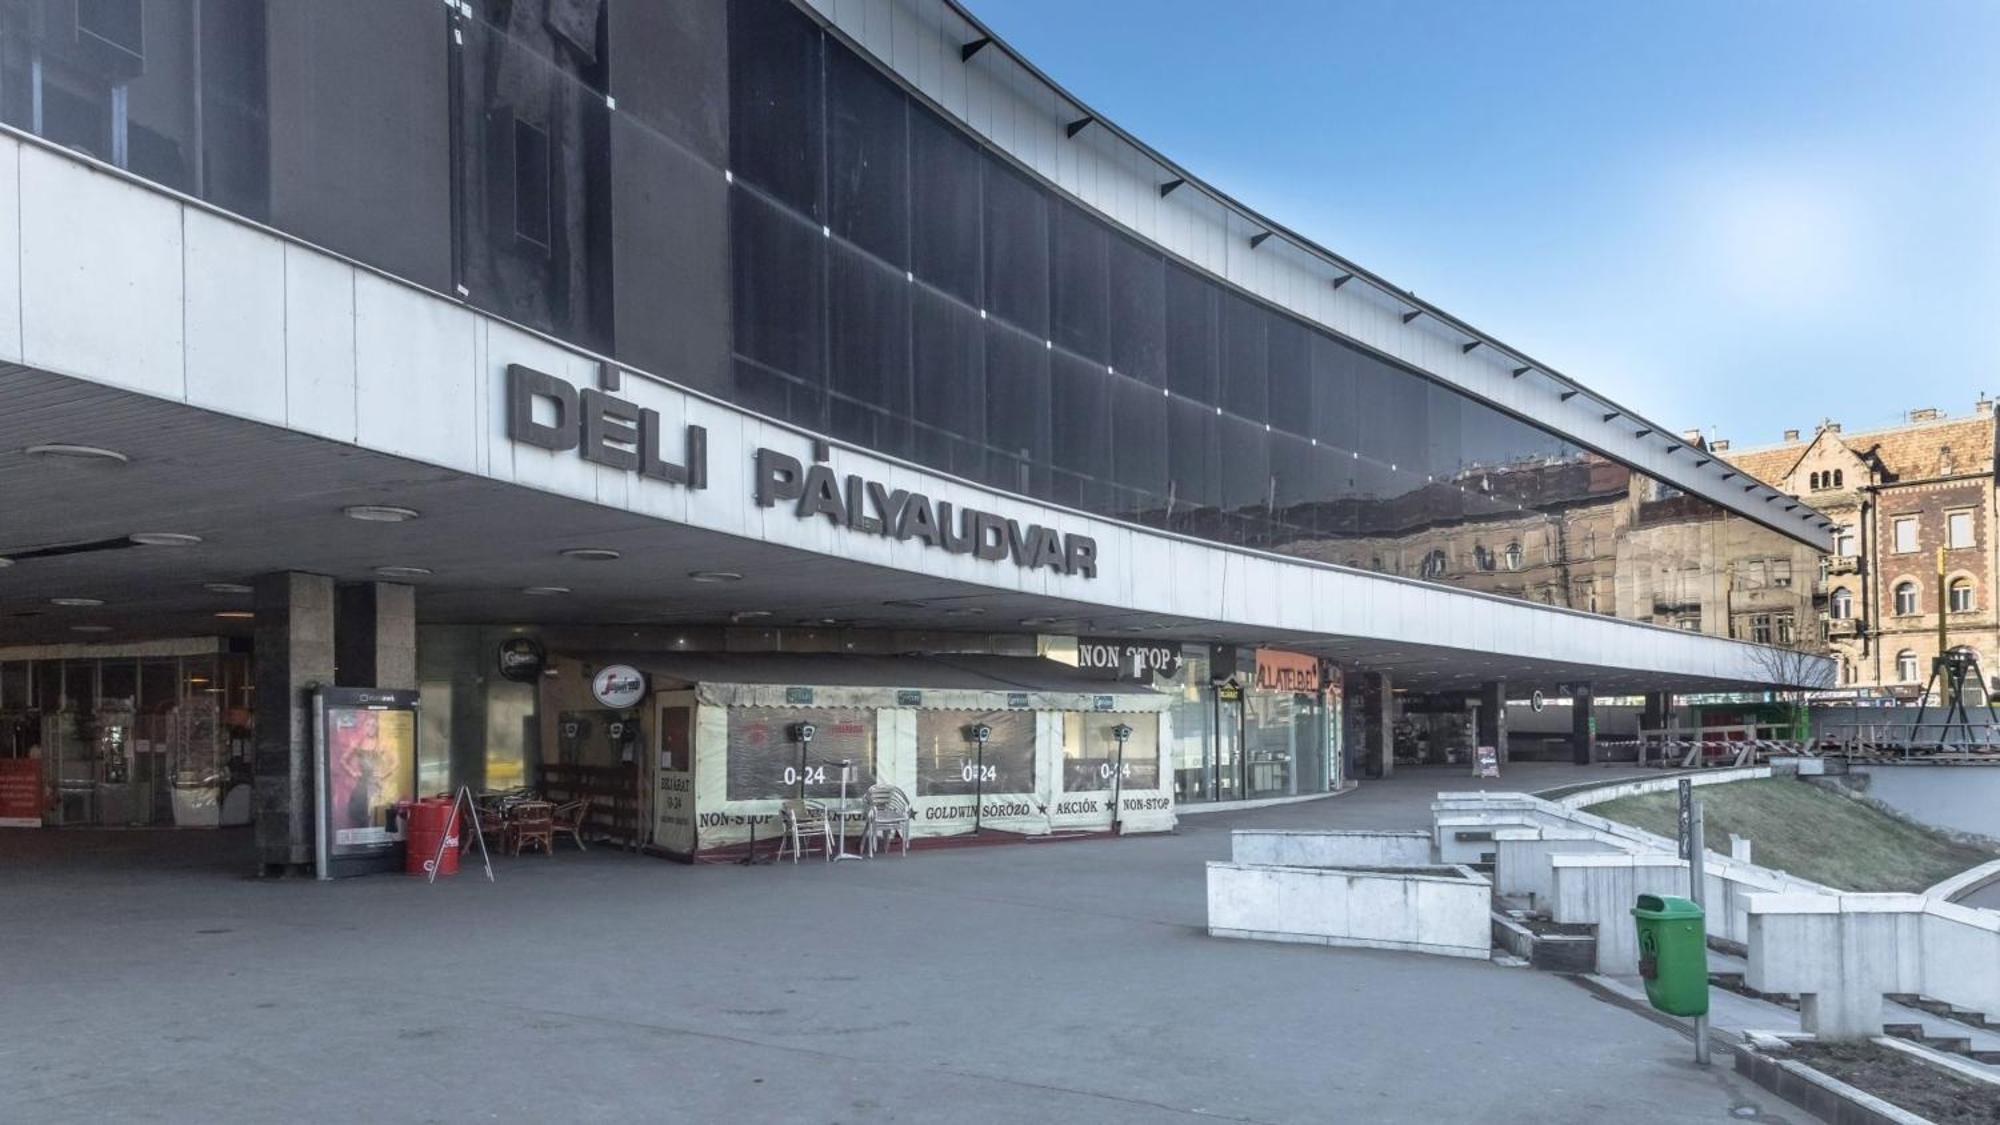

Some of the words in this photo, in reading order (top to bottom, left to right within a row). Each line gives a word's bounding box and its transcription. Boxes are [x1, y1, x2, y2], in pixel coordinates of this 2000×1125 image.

[507, 360, 707, 489] DÉLI
[754, 438, 1097, 578] PÁLYAUDVAR
[1080, 645, 1119, 667] NON
[784, 766, 826, 785] 0-24
[962, 764, 997, 782] 0-24
[926, 806, 979, 820] GOLDWIN
[1056, 798, 1098, 815] AKCIÓK
[1123, 798, 1170, 811] NON-STOP
